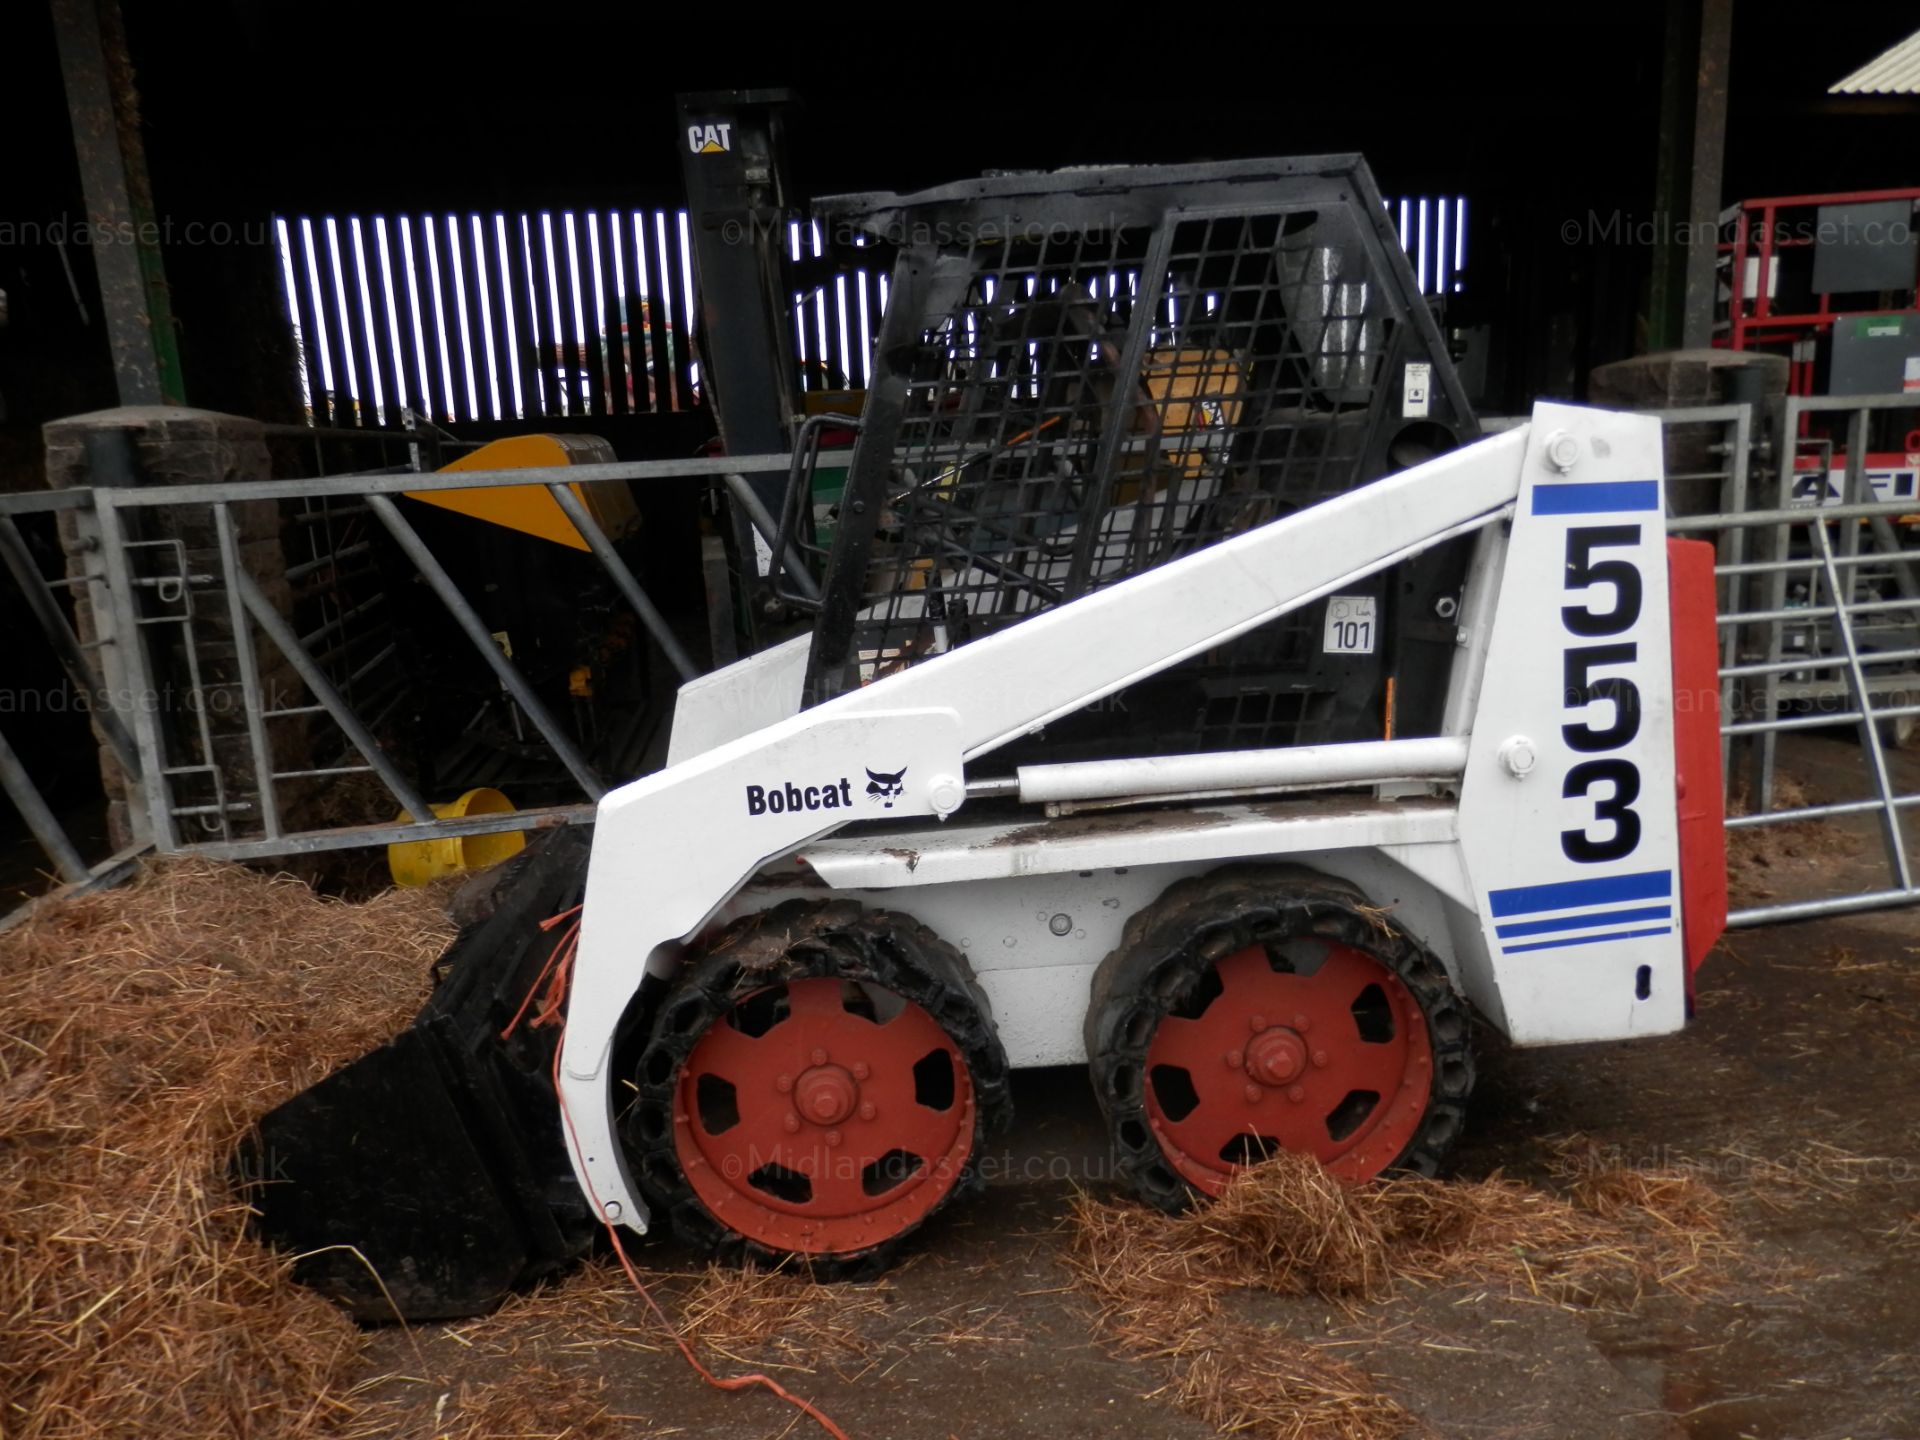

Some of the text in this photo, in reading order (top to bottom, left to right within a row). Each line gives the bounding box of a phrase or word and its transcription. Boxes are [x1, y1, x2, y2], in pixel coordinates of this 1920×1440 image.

[688, 124, 731, 154] CAT
[1333, 621, 1370, 649] 101
[1561, 524, 1642, 864] 553
[746, 778, 853, 816] Bobcat
